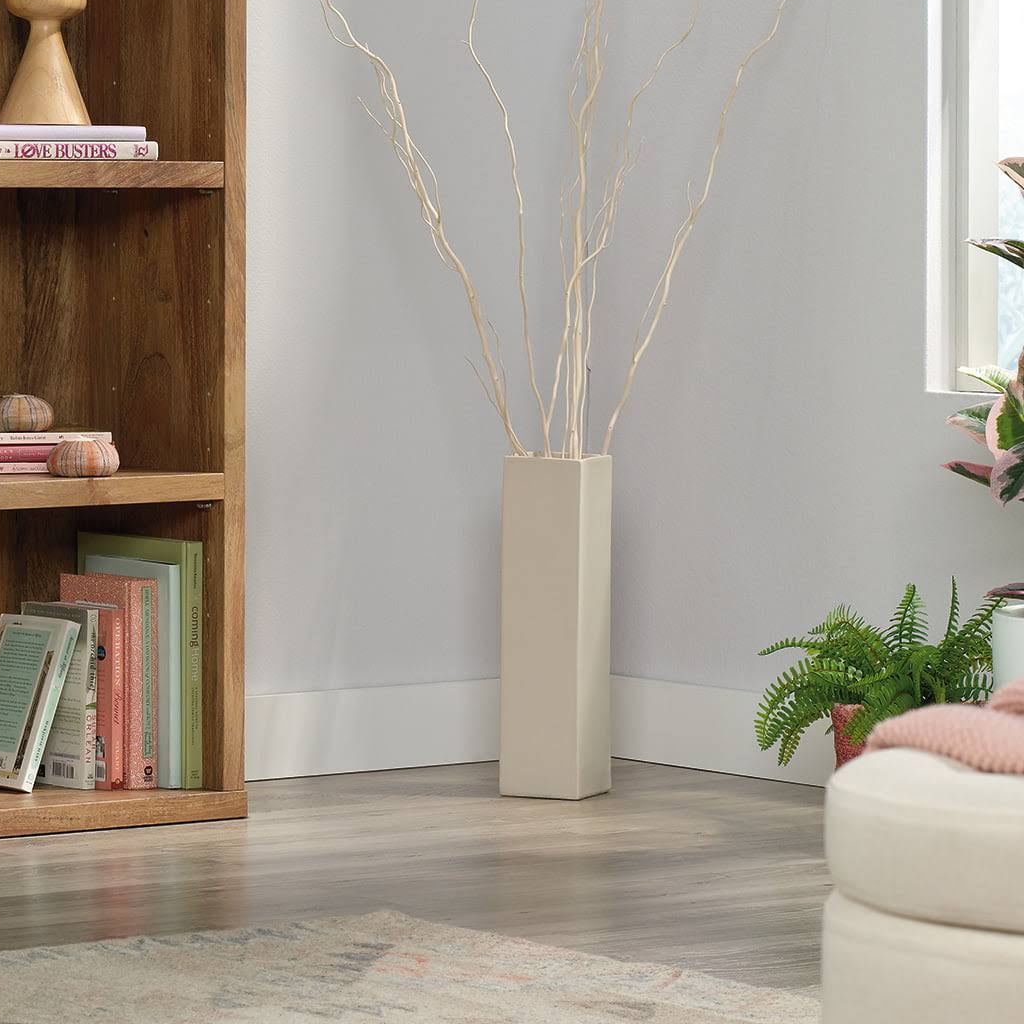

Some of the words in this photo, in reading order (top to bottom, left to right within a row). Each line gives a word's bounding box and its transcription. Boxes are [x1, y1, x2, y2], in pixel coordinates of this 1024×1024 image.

[14, 143, 52, 158] LOVE
[55, 143, 117, 158] BUSTERS
[189, 606, 199, 647] coming
